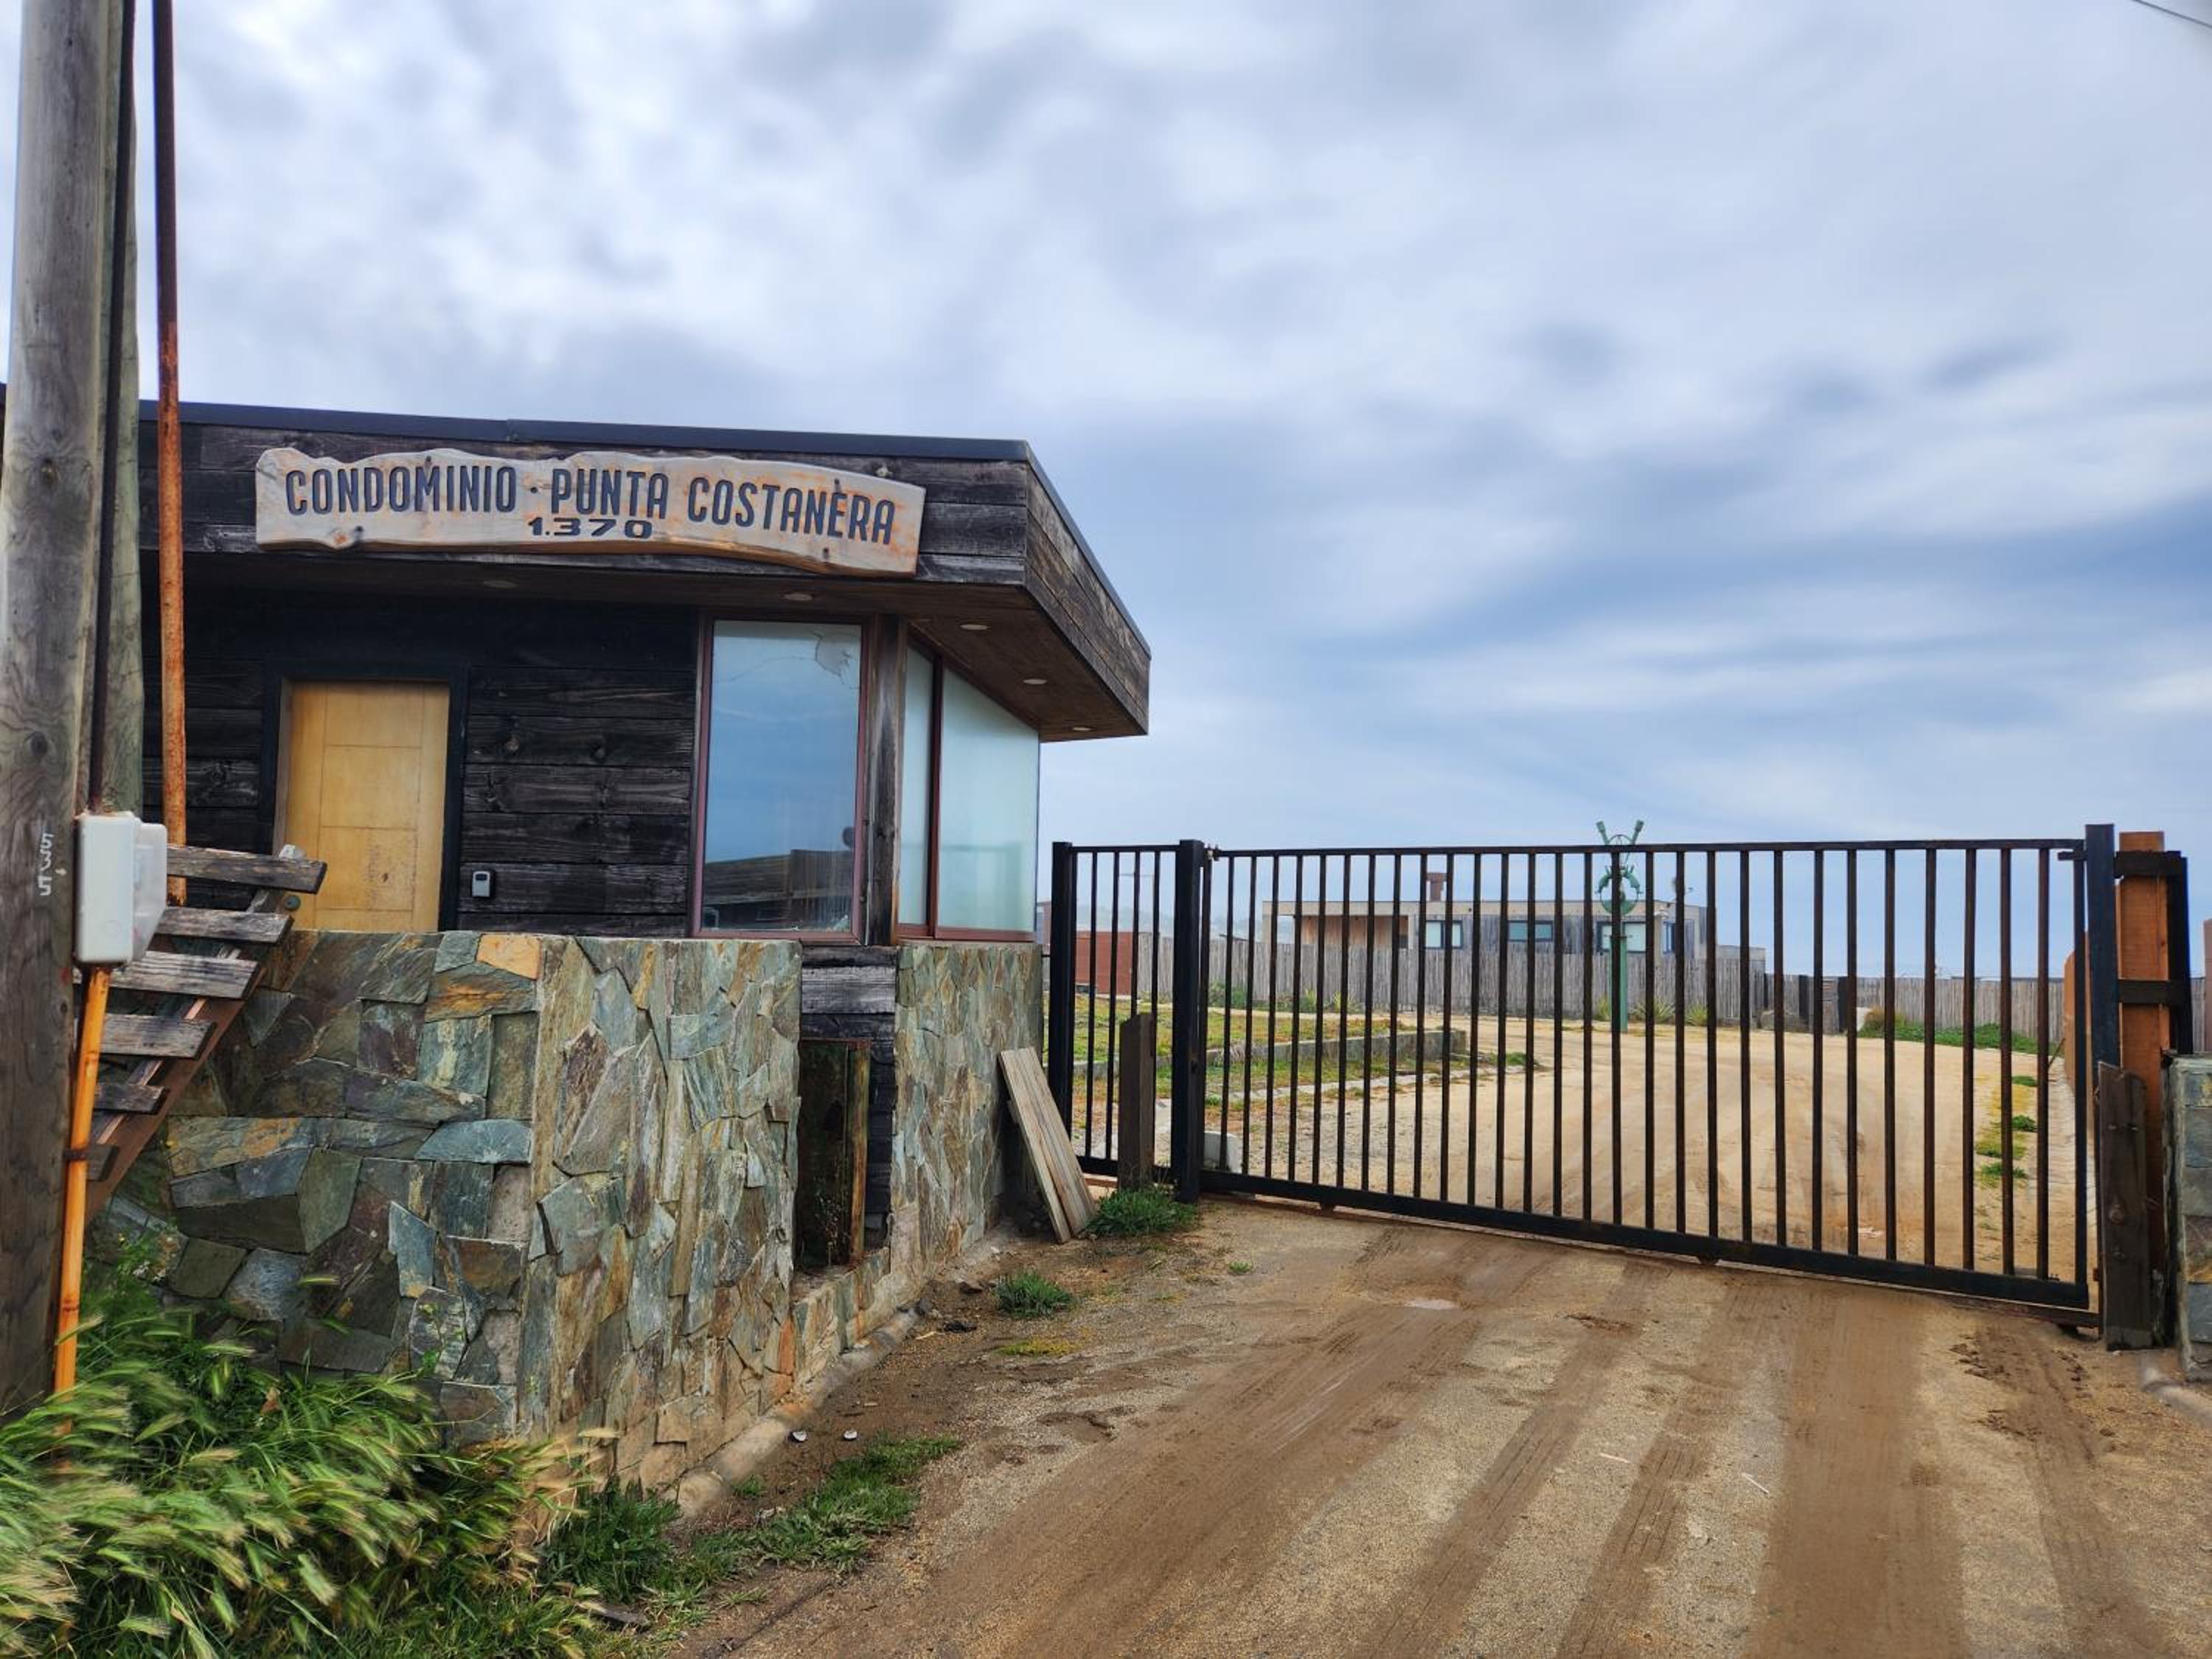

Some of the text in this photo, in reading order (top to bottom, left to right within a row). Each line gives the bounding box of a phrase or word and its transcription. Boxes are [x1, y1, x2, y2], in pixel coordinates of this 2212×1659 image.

[285, 465, 896, 545] CONDOMINIO PUNTA COSTANERA
[528, 517, 653, 539] 1.370
